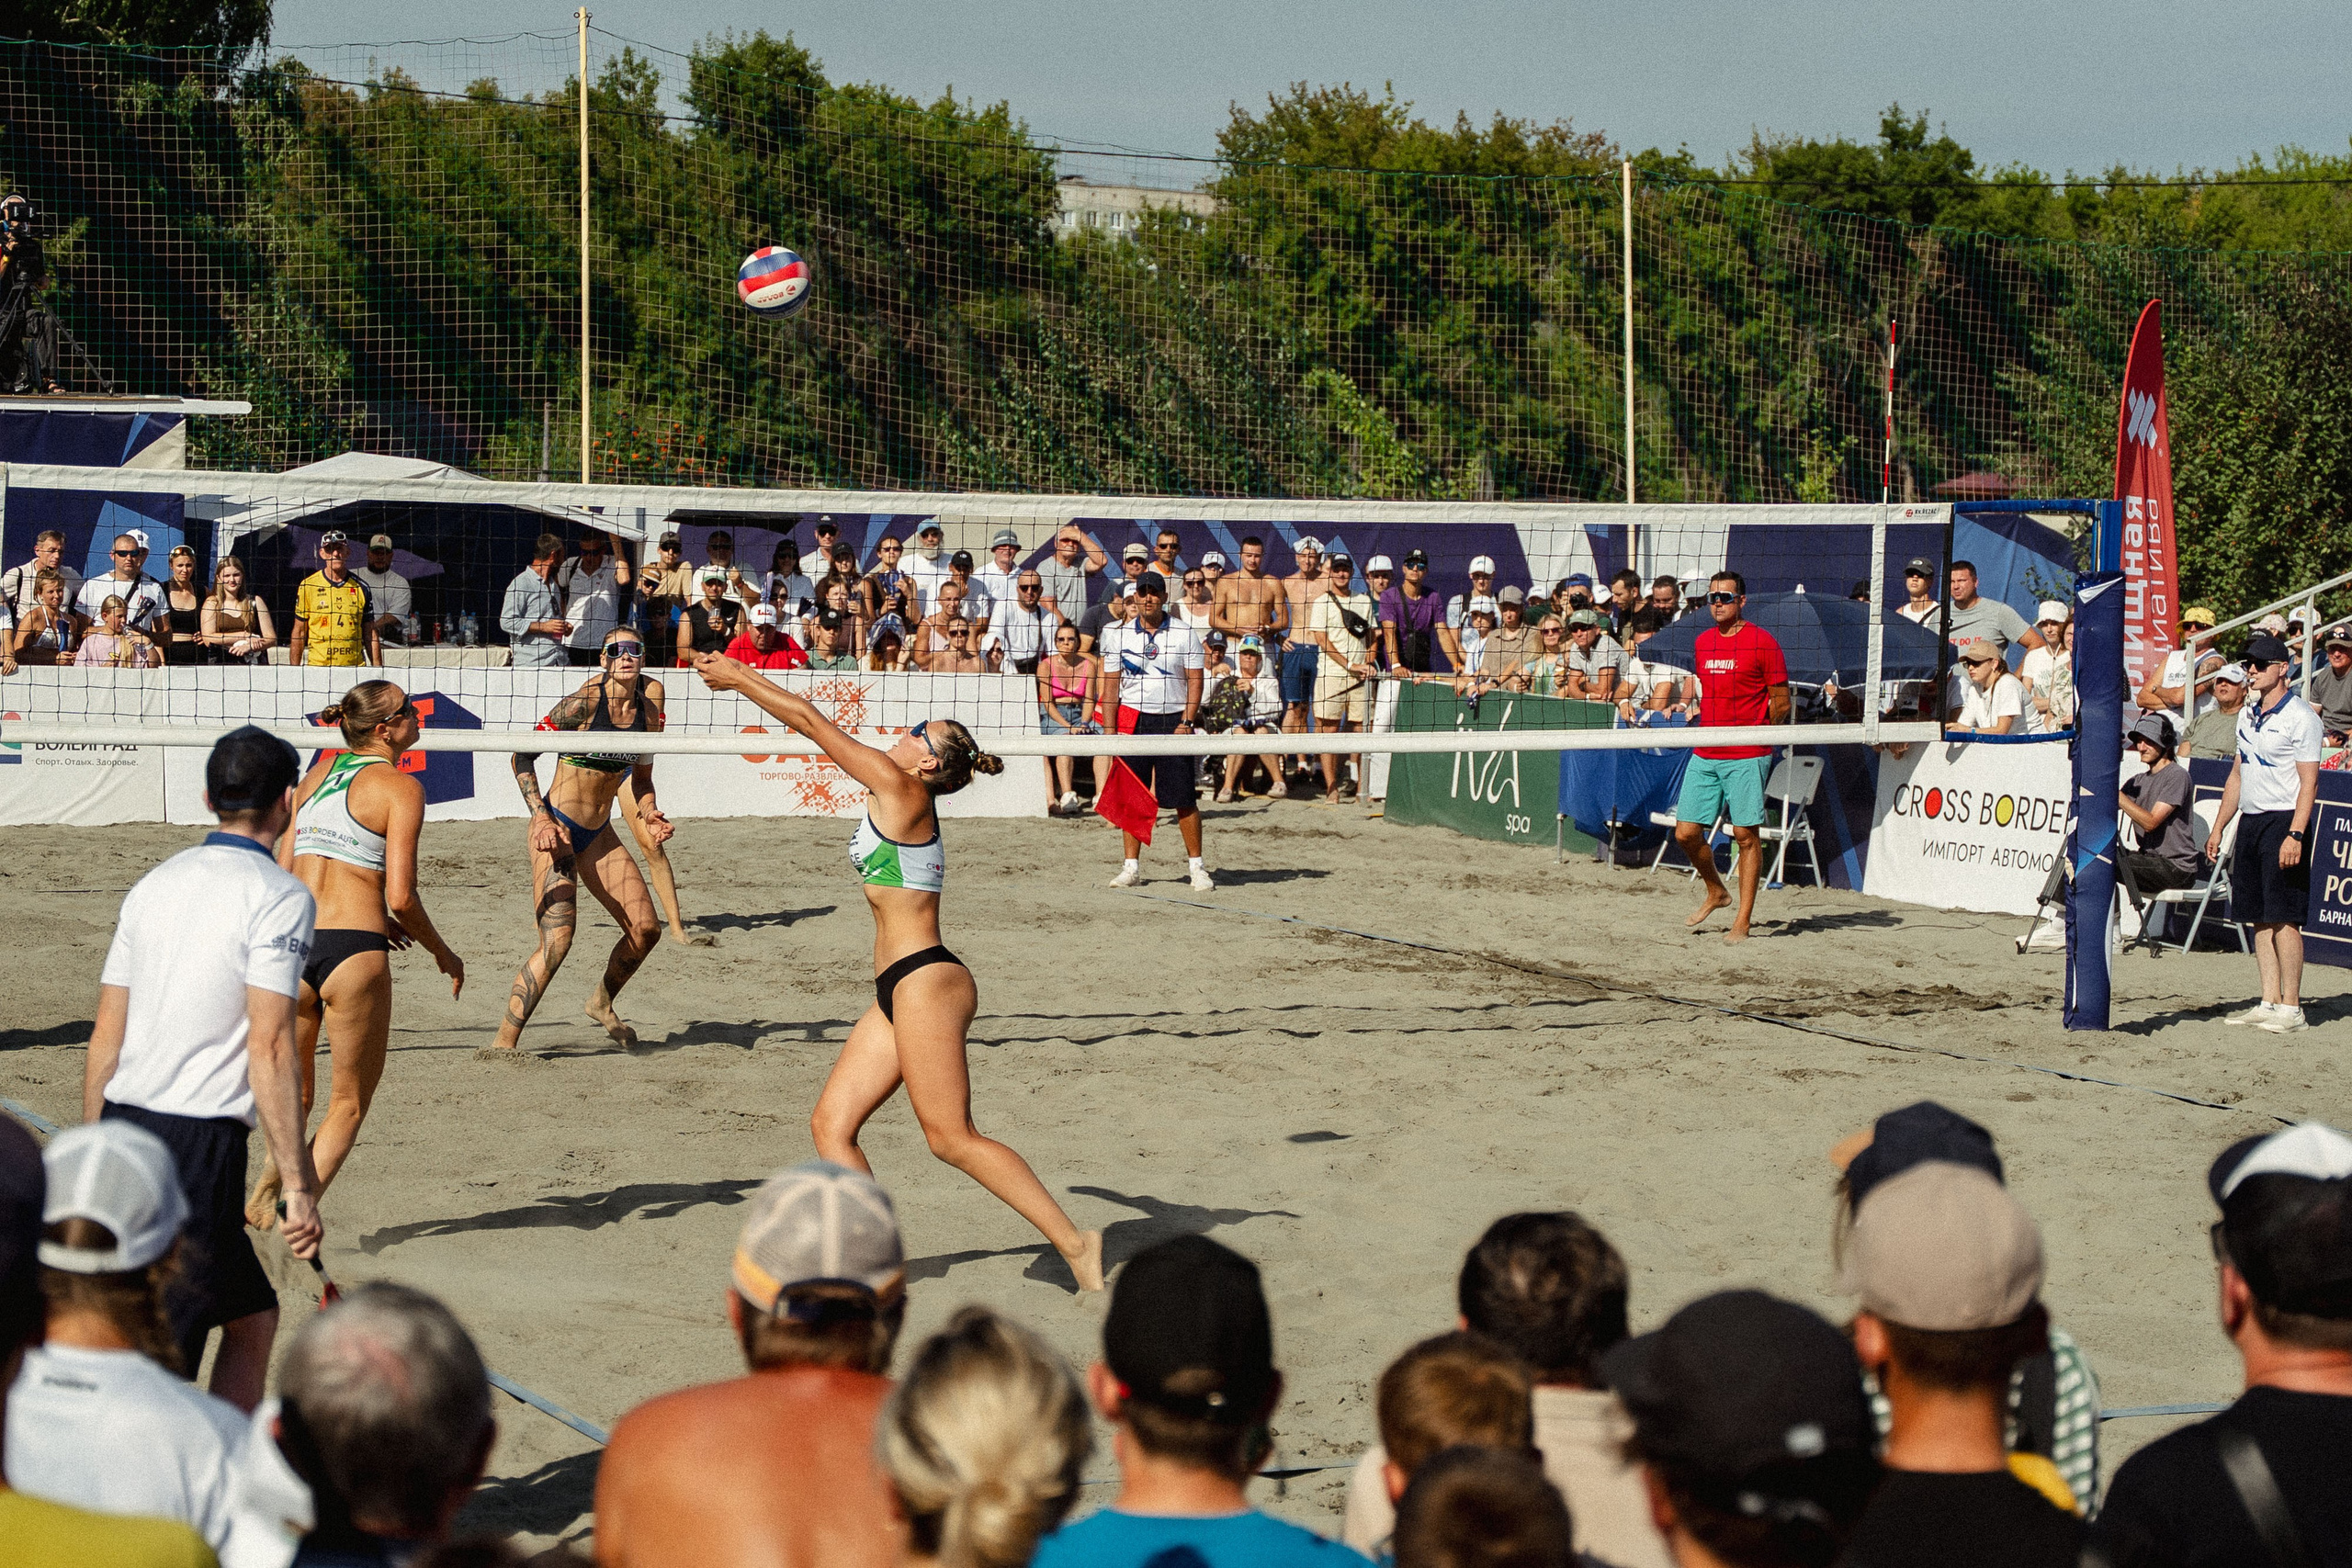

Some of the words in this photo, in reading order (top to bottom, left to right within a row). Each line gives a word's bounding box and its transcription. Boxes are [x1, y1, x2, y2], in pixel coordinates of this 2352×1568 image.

[2123, 495, 2147, 749] лищная
[1959, 637, 1972, 646] DO
[35, 758, 62, 766] Спорт.
[64, 758, 95, 766] Отдых.
[96, 759, 139, 767] Здоровье.
[334, 772, 345, 787] 1
[1894, 783, 1973, 824] CROSS
[1505, 813, 1532, 836] spa
[2335, 818, 2352, 833] ПЛ
[309, 826, 336, 838] BORDER
[338, 833, 359, 845] AUTO
[1922, 838, 1985, 863] ИМПОРТ
[2319, 908, 2352, 927] БАРНА
